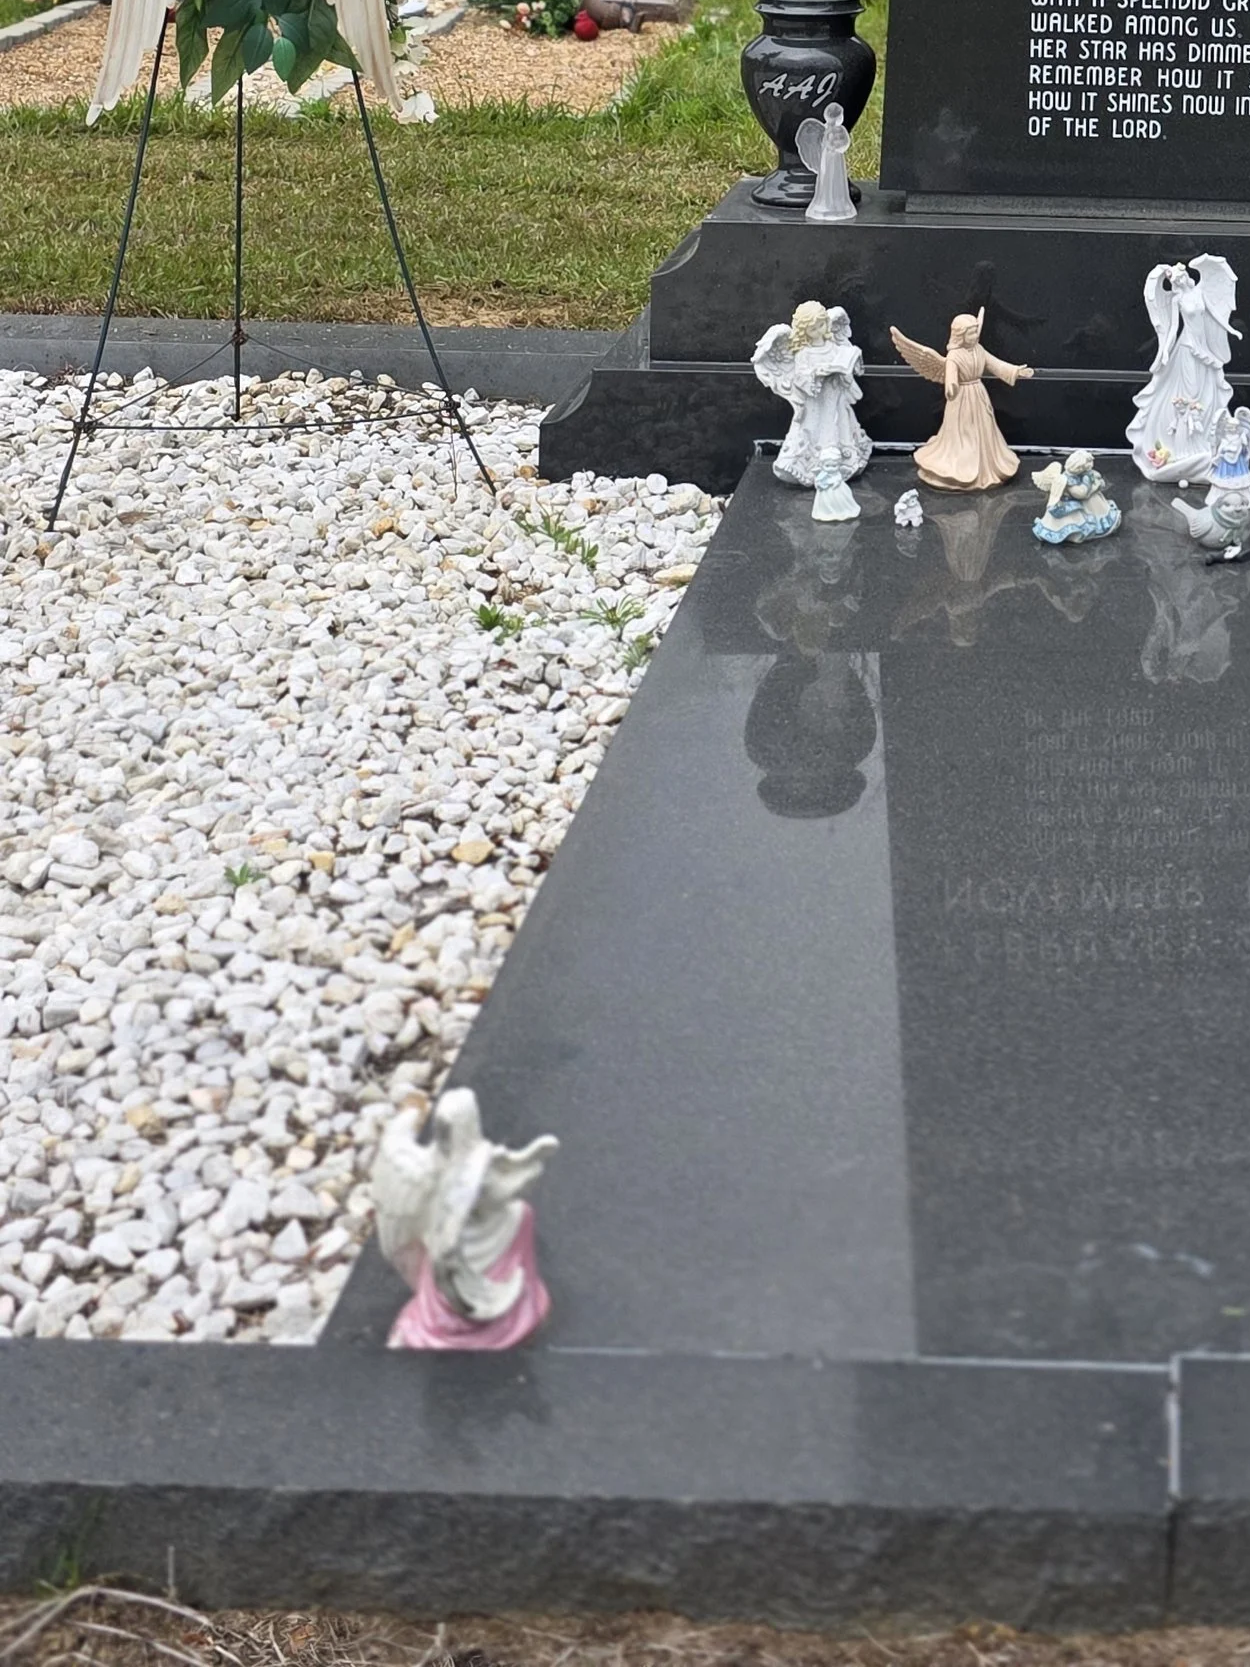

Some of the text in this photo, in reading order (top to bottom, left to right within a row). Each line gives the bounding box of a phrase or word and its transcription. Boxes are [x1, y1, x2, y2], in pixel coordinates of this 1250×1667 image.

[1030, 12, 1113, 34] WALKED
[1125, 14, 1199, 37] AMONG
[1211, 17, 1244, 40] US.
[1029, 38, 1068, 59] HER
[1078, 39, 1128, 61] STAR
[1138, 41, 1177, 63] HAS
[1029, 64, 1143, 87] REMEMBER
[1157, 67, 1202, 89] HOW
[1217, 69, 1235, 90] IT
[1028, 90, 1072, 112] HOW
[1081, 91, 1098, 112] IT
[1106, 92, 1173, 114] SHINES
[1182, 94, 1225, 116] NOW
[1028, 115, 1168, 141] OF THE LORD.
